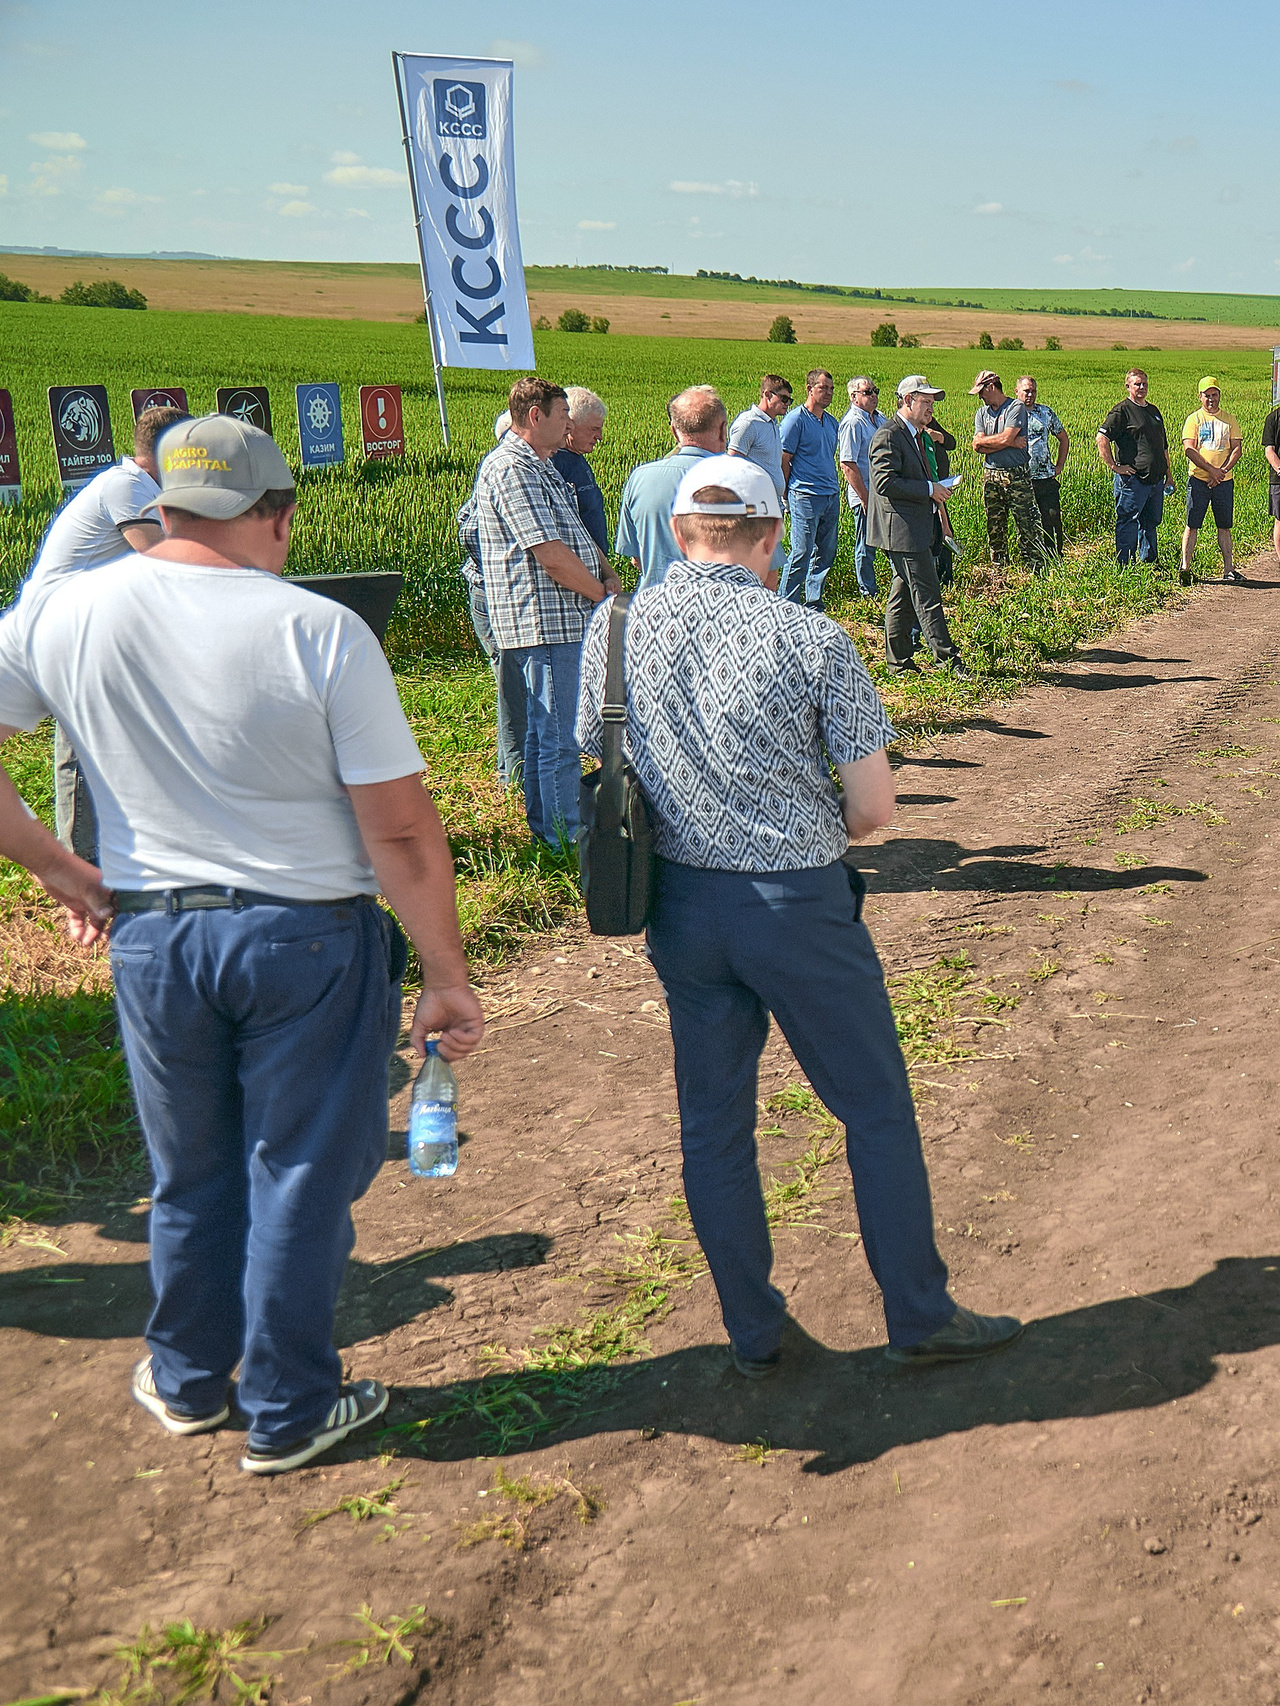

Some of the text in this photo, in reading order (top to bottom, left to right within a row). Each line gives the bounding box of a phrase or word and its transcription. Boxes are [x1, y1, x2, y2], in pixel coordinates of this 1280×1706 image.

[309, 443, 336, 454] КАЗИМ
[366, 440, 402, 452] ВОСТОРГ
[173, 447, 208, 459] AGRO
[61, 453, 112, 467] ТАЙГЕР 100
[172, 459, 232, 472] CAPITAL
